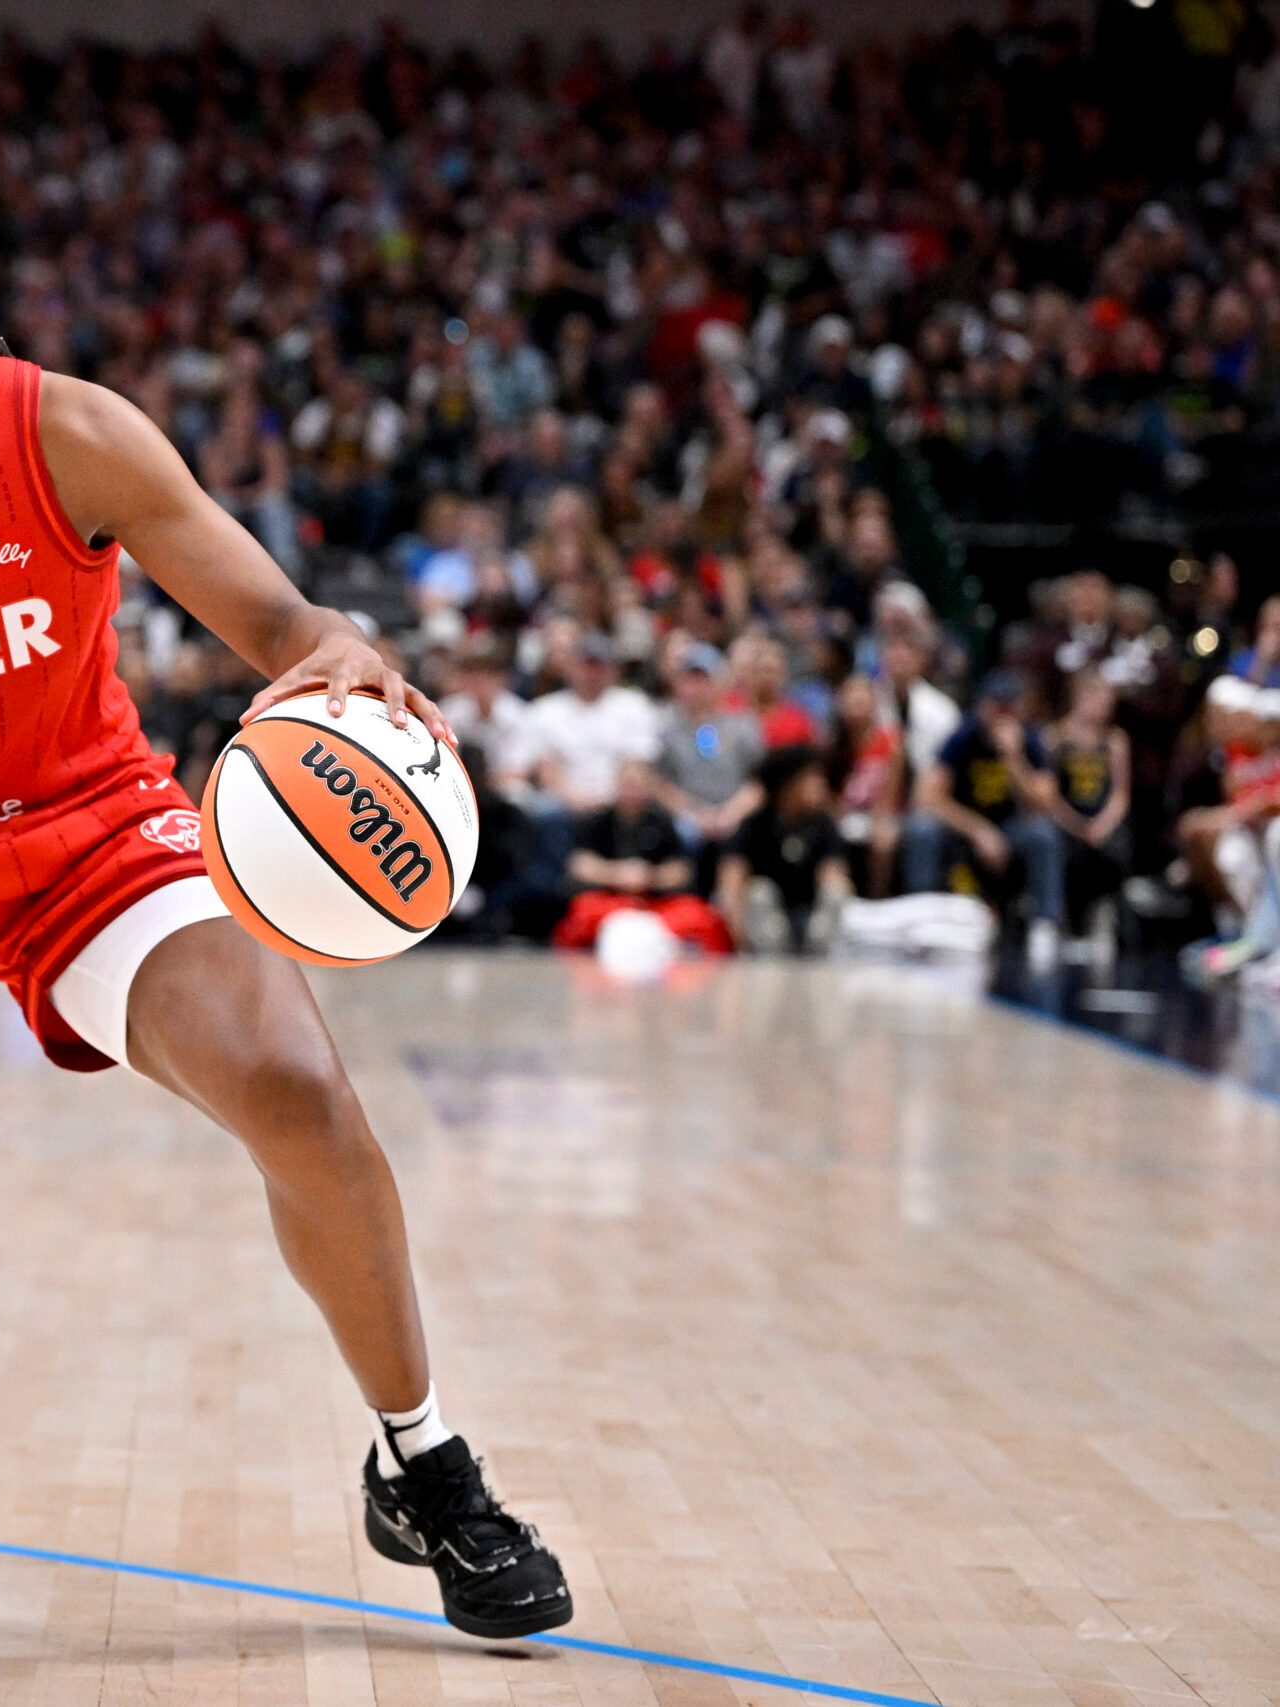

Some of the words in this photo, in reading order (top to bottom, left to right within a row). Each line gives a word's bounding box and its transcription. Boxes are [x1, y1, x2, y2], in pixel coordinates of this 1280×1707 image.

[374, 778, 393, 796] NXT
[393, 797, 410, 816] EVO
[299, 738, 433, 905] Wilson
